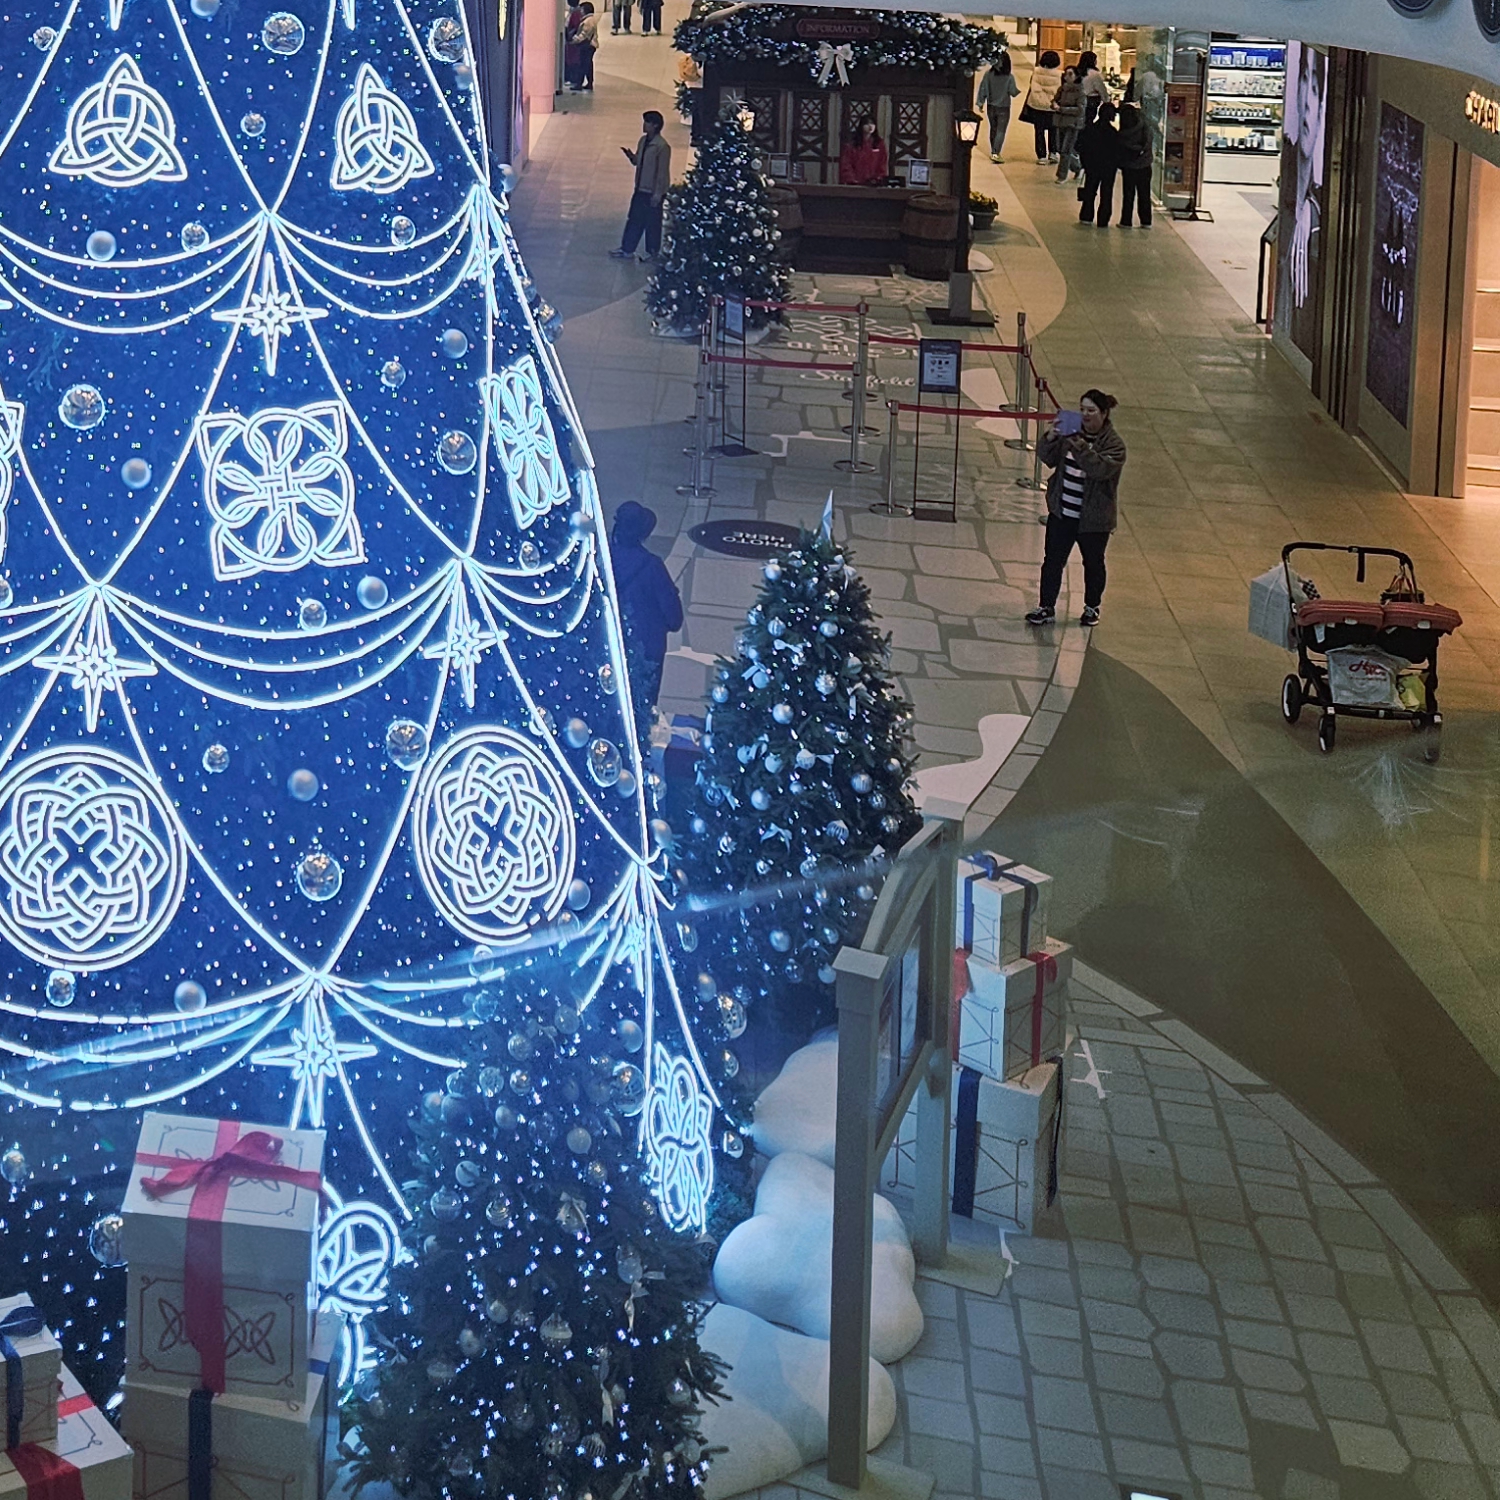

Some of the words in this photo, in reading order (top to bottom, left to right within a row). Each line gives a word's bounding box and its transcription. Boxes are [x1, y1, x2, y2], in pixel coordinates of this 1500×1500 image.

[805, 24, 870, 34] INFORMATION
[800, 369, 916, 389] Stafield
[722, 536, 792, 549] PHOTO
[732, 531, 785, 543] HERE
